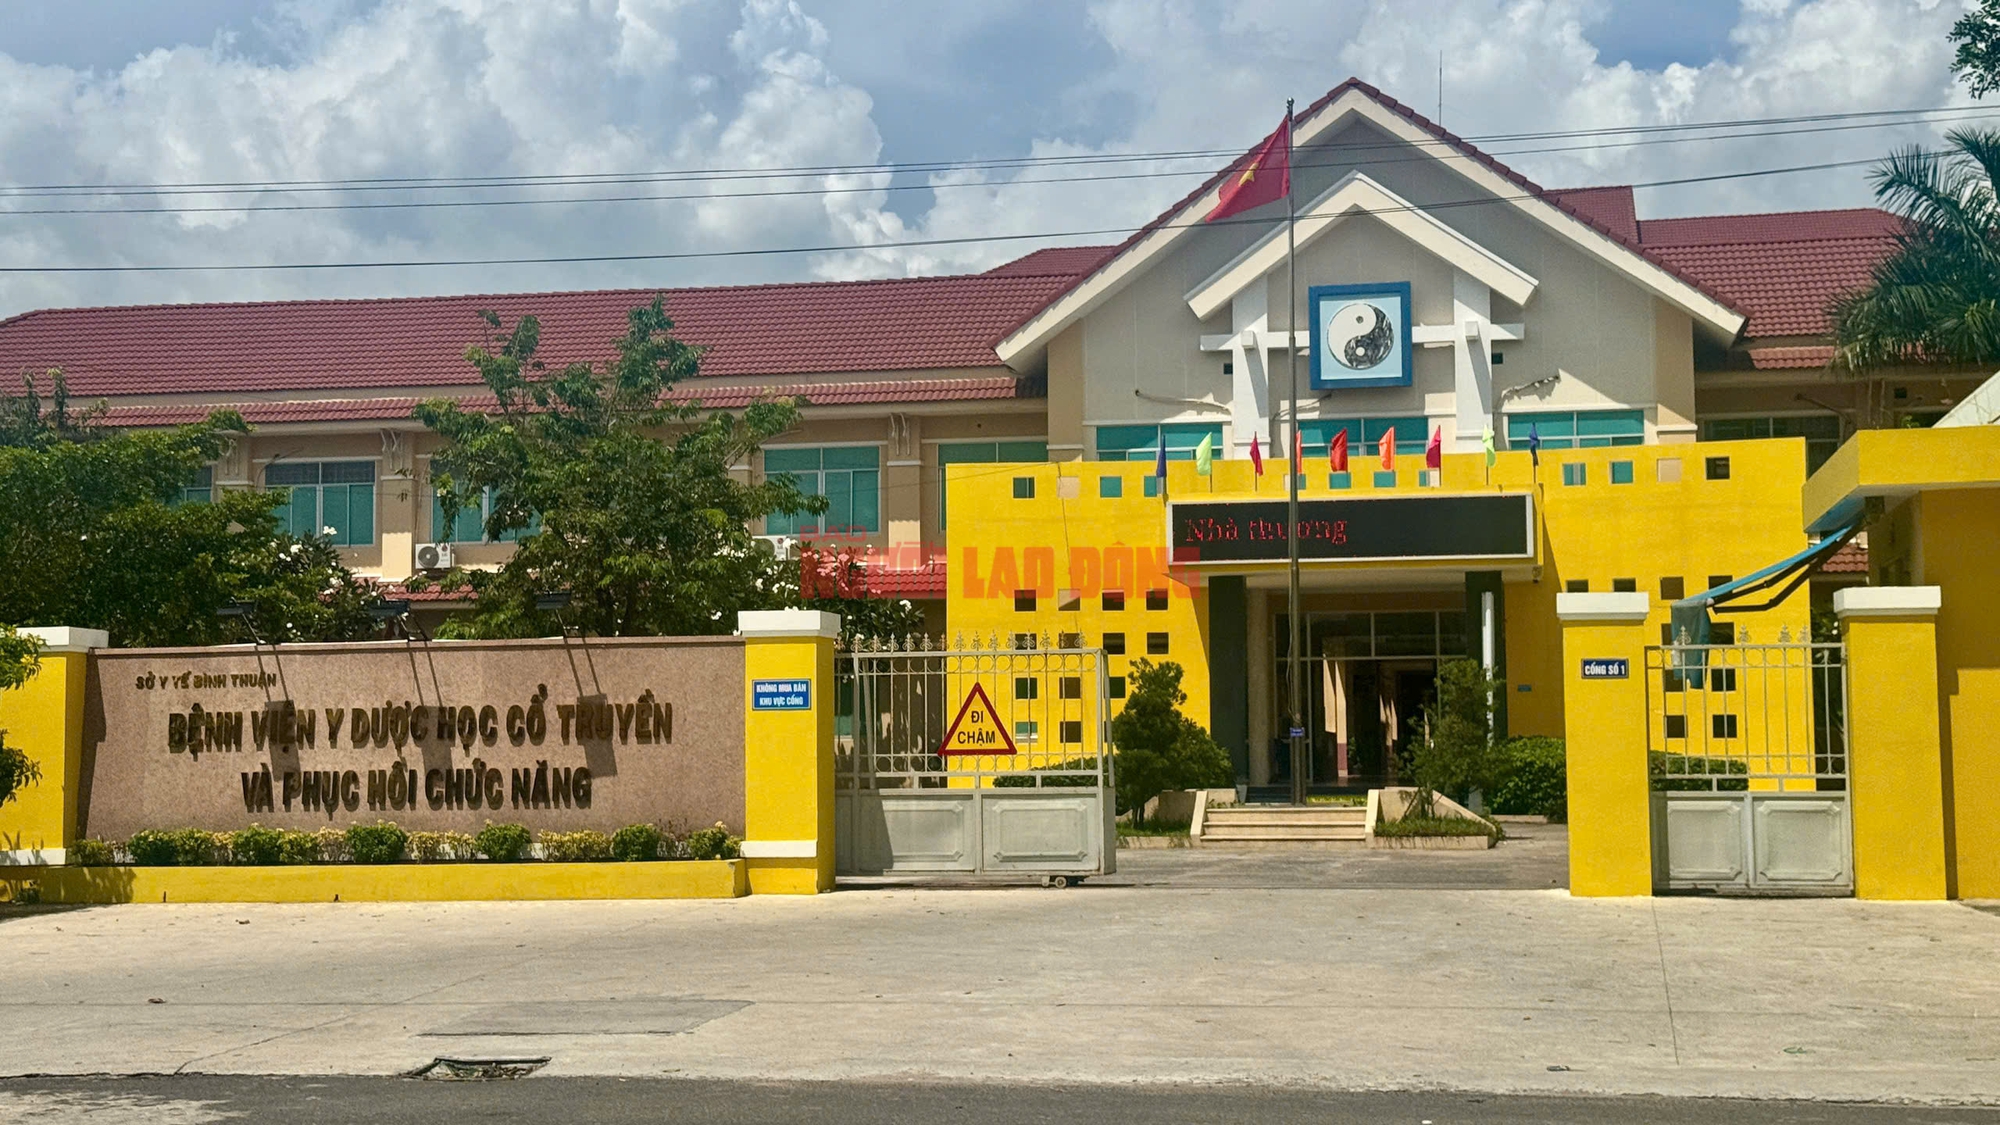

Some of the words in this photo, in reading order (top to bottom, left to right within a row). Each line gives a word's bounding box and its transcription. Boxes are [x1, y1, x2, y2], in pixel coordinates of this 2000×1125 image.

[1608, 661, 1619, 675] SỐ
[1621, 665, 1625, 675] 1
[135, 671, 156, 690] SỞ
[159, 676, 168, 690] Y
[193, 672, 227, 689] BÌNH
[230, 671, 277, 690] THUẬN
[757, 683, 777, 692] KHÔNG
[778, 683, 793, 692] MUA
[793, 682, 806, 692] BÁN
[759, 697, 772, 705] KHU
[773, 696, 786, 706] VỰC
[168, 703, 243, 757] BỆNH
[251, 700, 316, 753] VIỆN
[325, 708, 344, 747] Y
[351, 700, 429, 756] DƯỢC
[437, 704, 498, 755] HỌC
[506, 684, 548, 746] CỔ
[556, 689, 673, 744] TRUYỀN
[971, 710, 984, 723] ĐI
[957, 728, 996, 746] CHẬM
[241, 762, 275, 812] VÀ
[283, 769, 360, 820] PHỤC
[367, 761, 417, 811] HỒI
[424, 758, 504, 809] CHỨC
[511, 760, 592, 808] NĂNG
